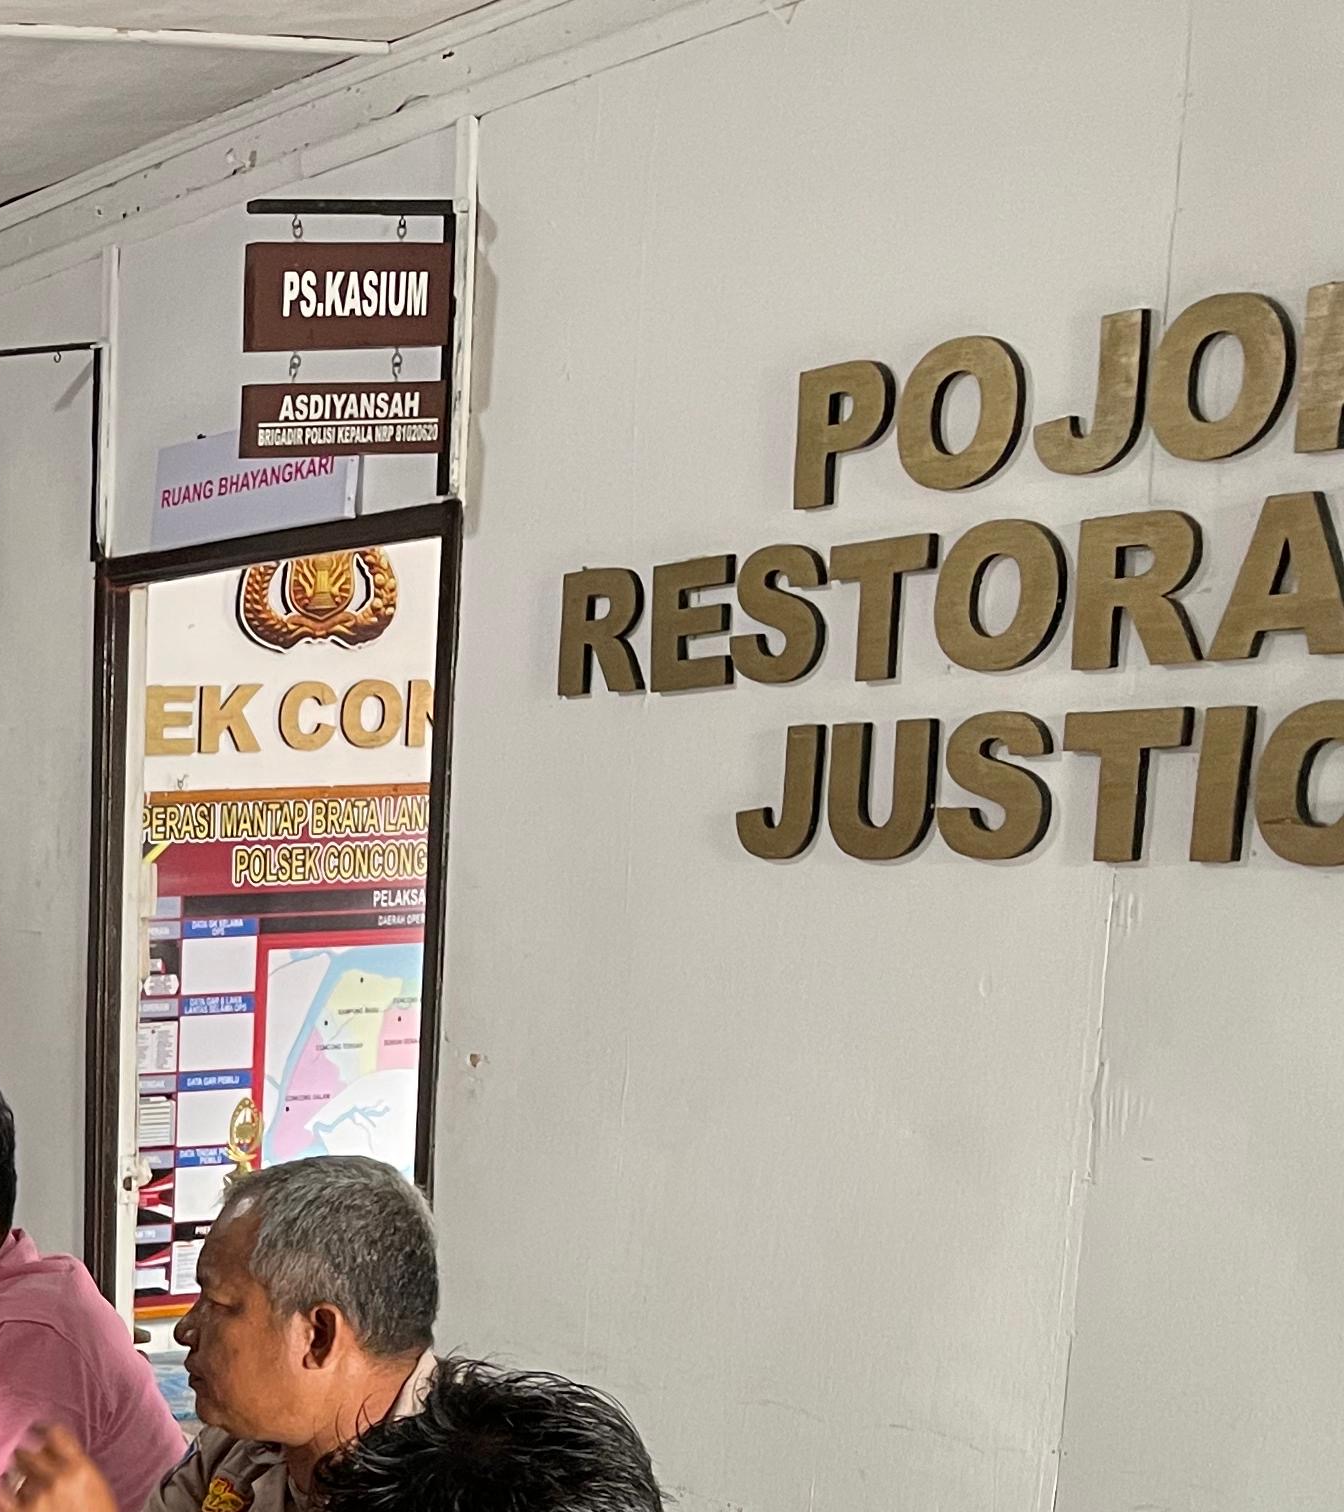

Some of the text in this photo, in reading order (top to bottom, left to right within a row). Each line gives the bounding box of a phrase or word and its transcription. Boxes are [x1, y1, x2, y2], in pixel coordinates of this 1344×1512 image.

[281, 270, 430, 318] PS.KASIUM
[278, 392, 421, 421] ASDIYANSAH
[257, 429, 304, 447] BRIGADIR
[304, 427, 337, 445] POLISI
[337, 425, 374, 445] KEPALA
[374, 425, 395, 443] NRP
[161, 455, 336, 509] RUANG BHAYANGKARI
[557, 490, 1344, 698] RESTORA
[144, 682, 264, 756] EK
[221, 800, 308, 838] MANTAP
[311, 798, 379, 836] BRATA
[383, 796, 430, 833] LAN
[235, 842, 427, 884] POLSEK CONCONG
